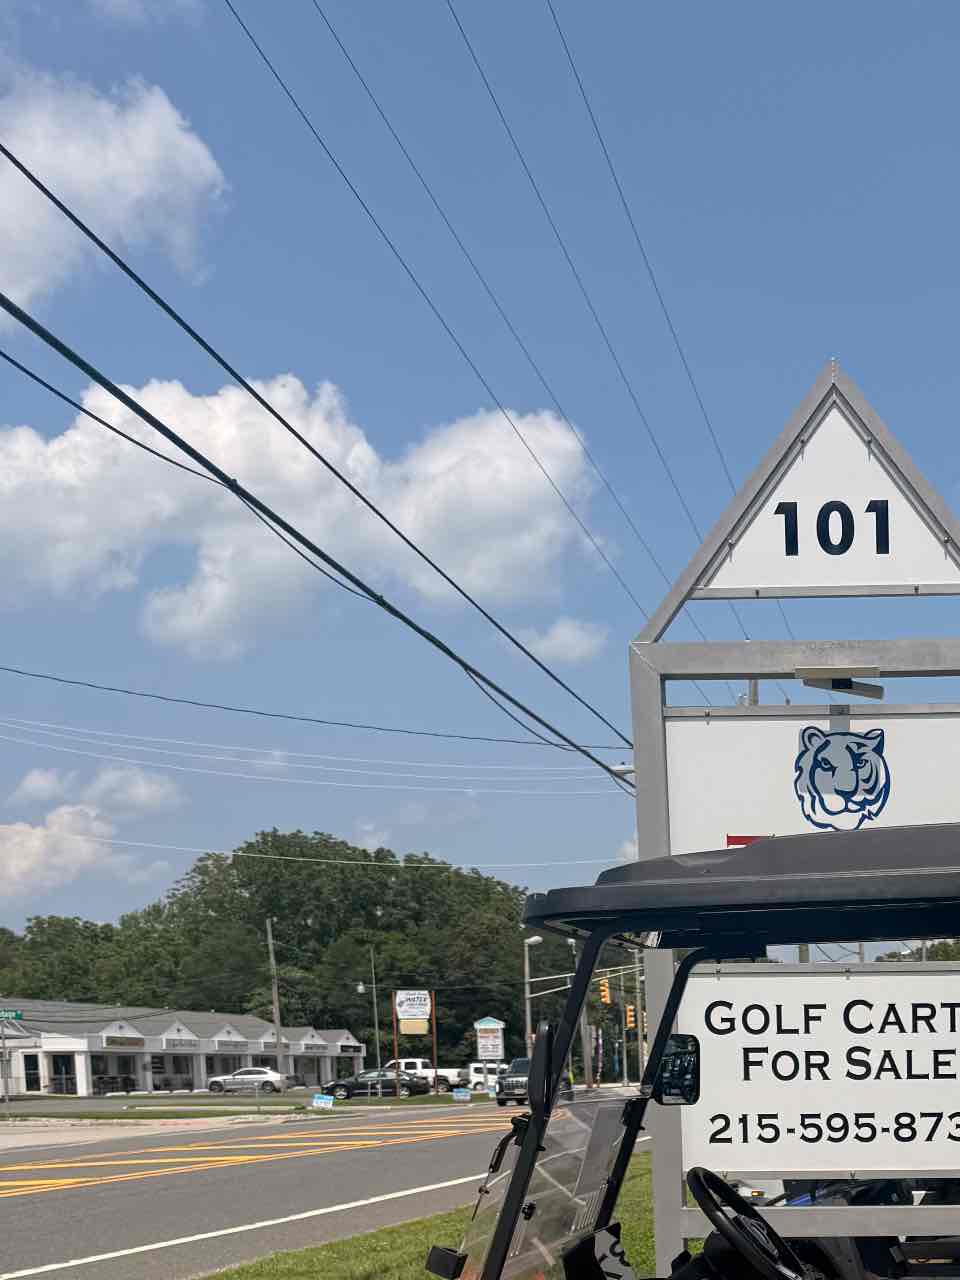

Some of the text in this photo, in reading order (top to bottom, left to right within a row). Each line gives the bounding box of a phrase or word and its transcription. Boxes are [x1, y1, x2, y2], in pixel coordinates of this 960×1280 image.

[774, 499, 890, 556] 101
[705, 1001, 827, 1035] GOLF
[742, 1046, 957, 1081] FOR SALE
